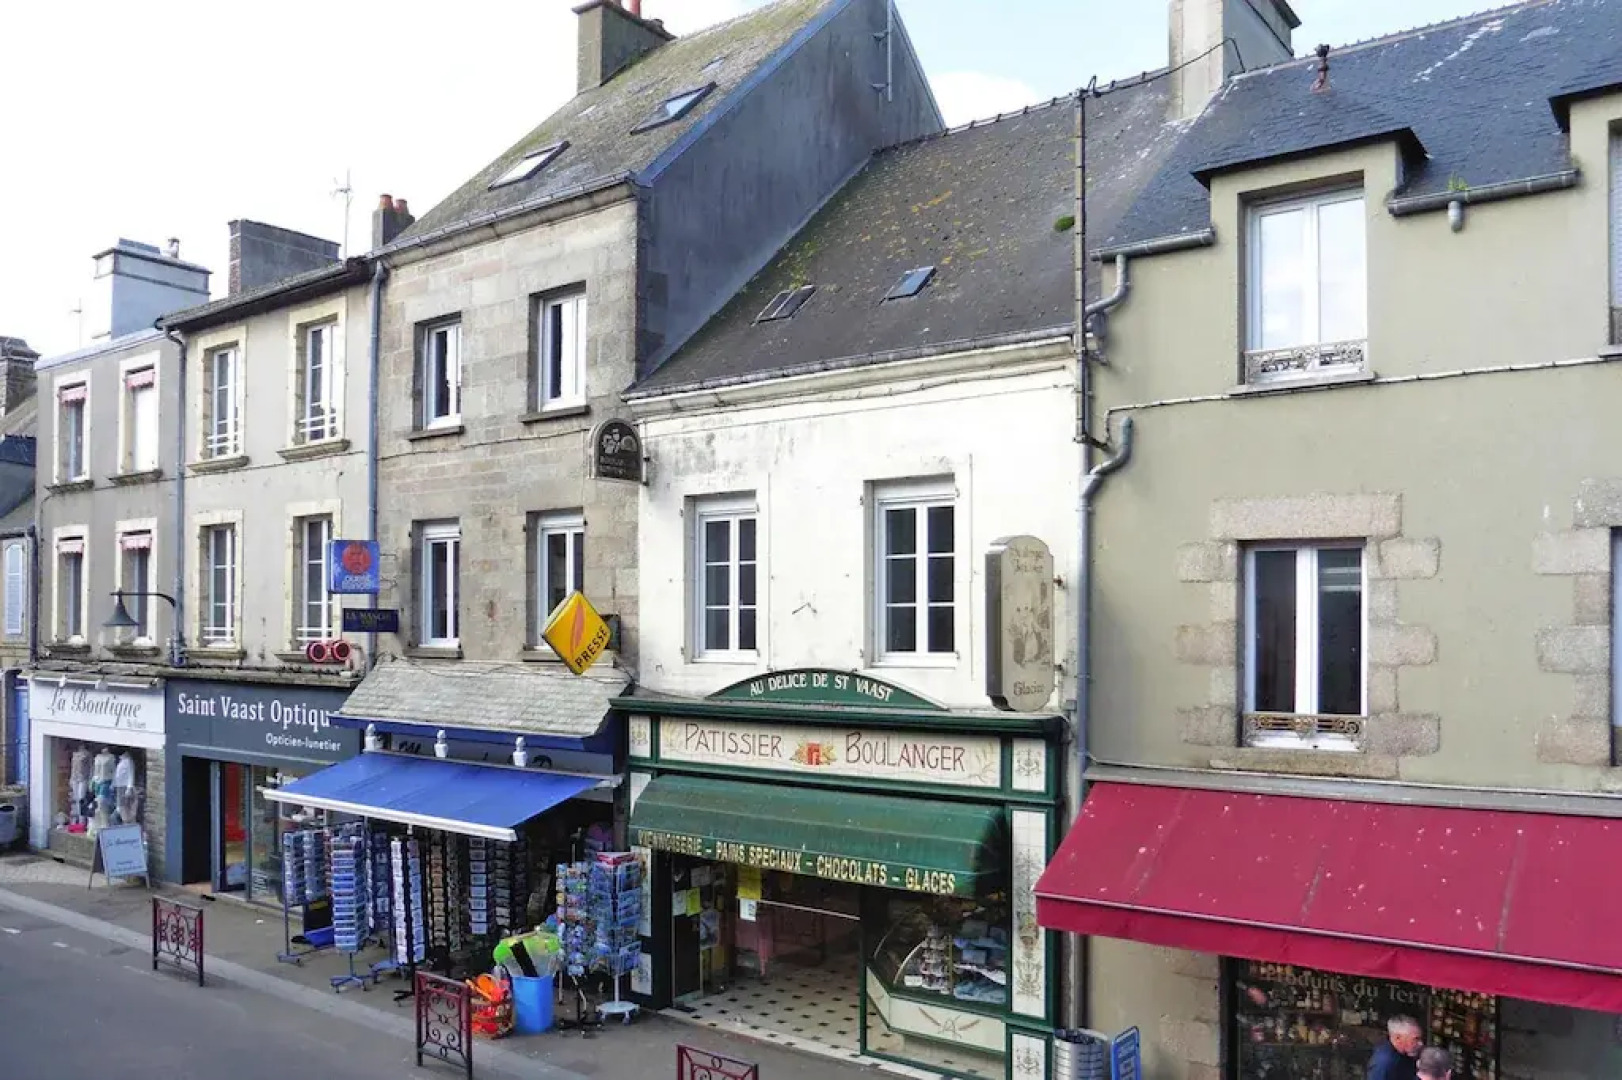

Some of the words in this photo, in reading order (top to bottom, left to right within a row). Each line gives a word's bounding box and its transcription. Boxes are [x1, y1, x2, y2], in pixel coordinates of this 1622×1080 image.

[574, 625, 607, 668] PRESSE
[47, 686, 66, 716] La
[71, 688, 142, 727] Boutique
[750, 681, 764, 697] AU
[767, 672, 807, 691] DELICE
[812, 672, 828, 688] DE
[834, 673, 850, 690] ST
[856, 677, 894, 702] VAAST
[178, 692, 216, 717] Saint
[221, 696, 265, 722] Vaast
[270, 699, 341, 733] Optiqu
[265, 732, 342, 751] Opticien-lunetier
[684, 722, 783, 758] PATISSIER
[844, 730, 966, 772] BOULANGER
[715, 840, 745, 864] PAINS
[749, 845, 802, 872] SPECIAUX
[816, 855, 888, 885] CHOCOLATS
[905, 868, 956, 894] GLACES
[1353, 978, 1379, 998] du
